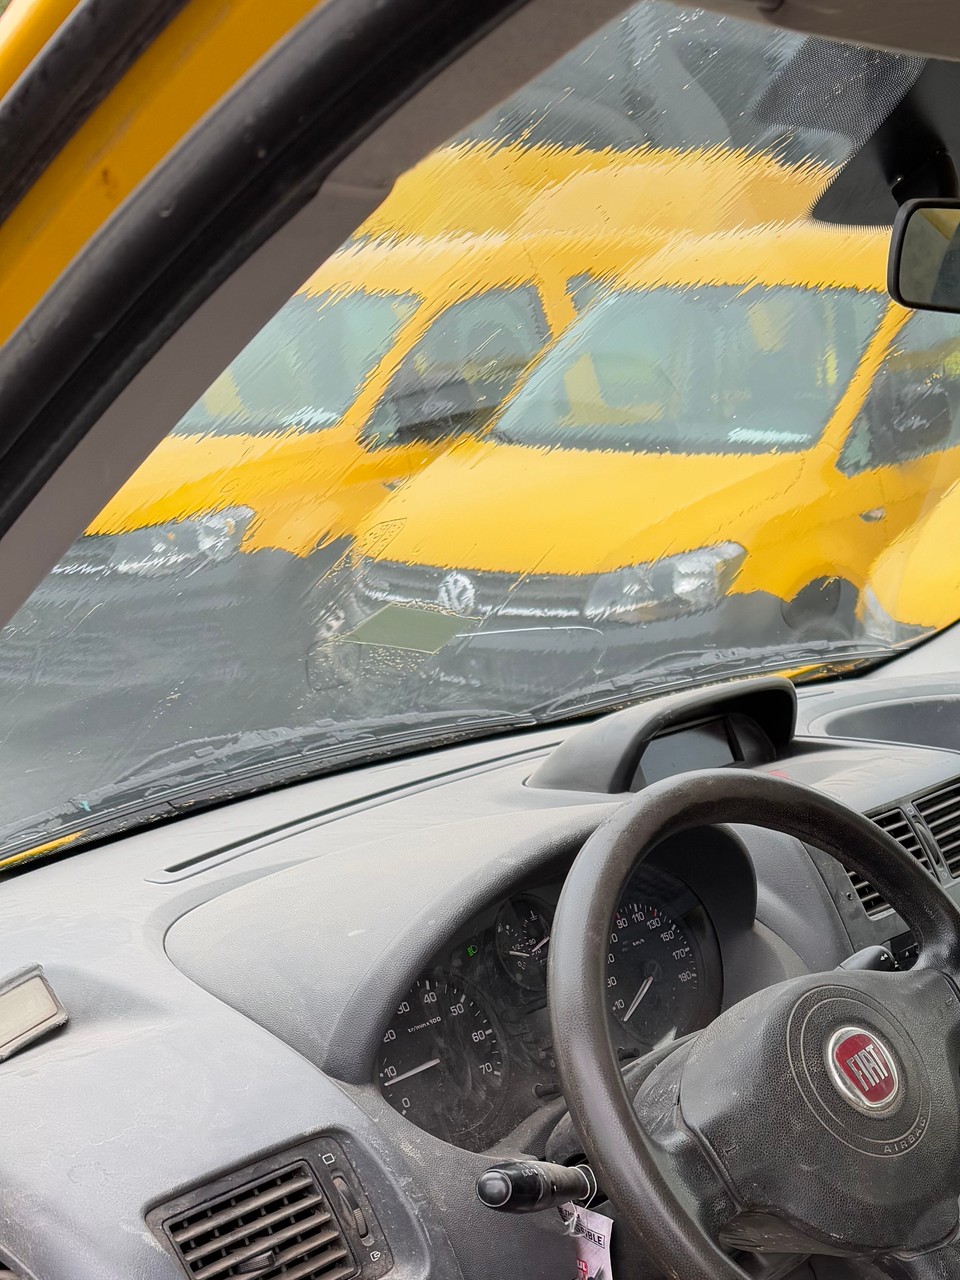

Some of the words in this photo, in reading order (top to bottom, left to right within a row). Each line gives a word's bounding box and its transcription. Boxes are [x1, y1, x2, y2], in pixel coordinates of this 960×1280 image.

[616, 917, 628, 929] 90
[631, 911, 645, 923] 110
[646, 917, 661, 930] 130
[660, 930, 675, 942] 150
[607, 953, 615, 964] 0
[672, 948, 686, 960] 170
[678, 971, 692, 983] 190
[423, 991, 438, 1004] 40
[397, 1001, 410, 1015] 30
[450, 1003, 464, 1016] 50
[614, 999, 625, 1010] 10
[471, 1030, 486, 1043] 60
[384, 1065, 397, 1078] 10
[479, 1062, 492, 1074] 70
[846, 1044, 888, 1091] FIAT
[401, 1097, 410, 1107] 0
[884, 1116, 928, 1153] AIRBAG
